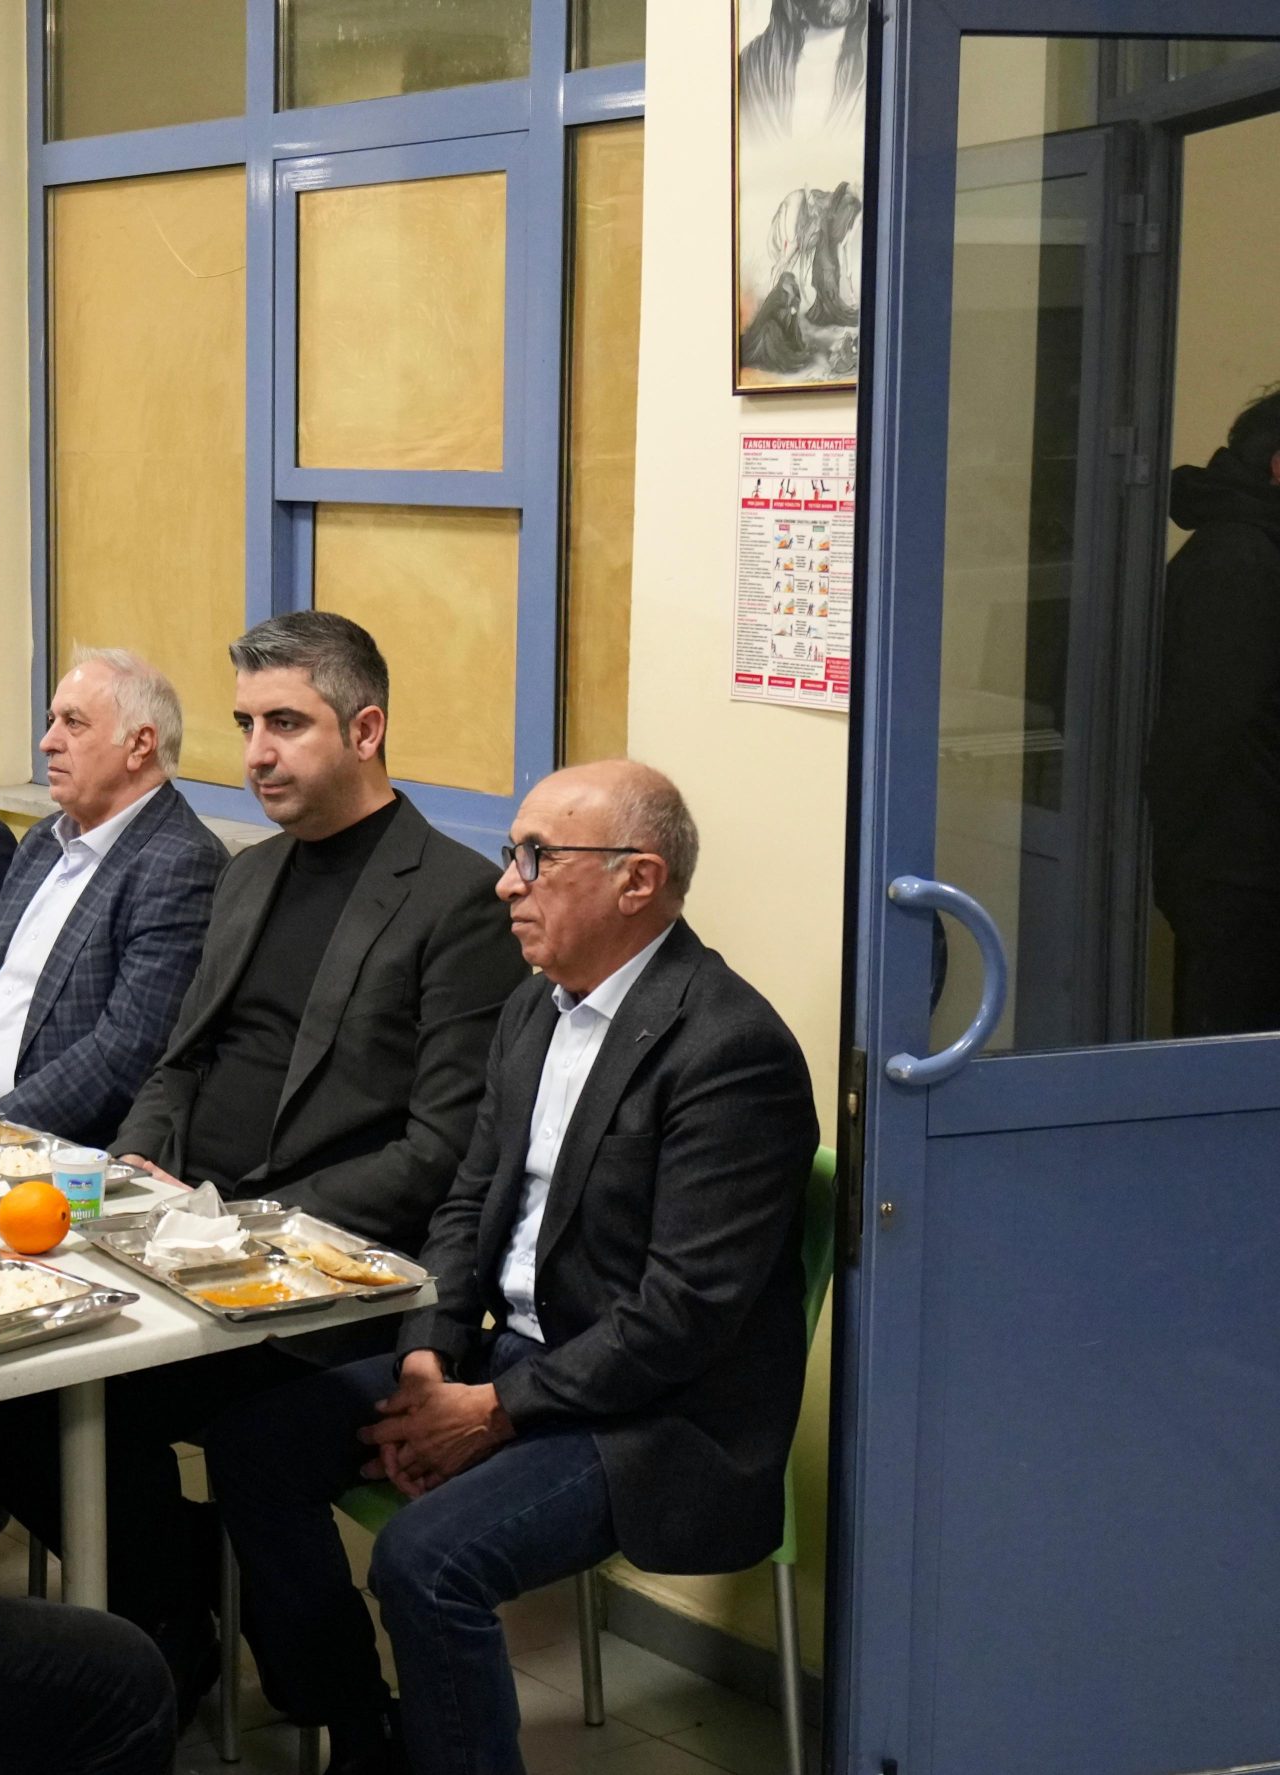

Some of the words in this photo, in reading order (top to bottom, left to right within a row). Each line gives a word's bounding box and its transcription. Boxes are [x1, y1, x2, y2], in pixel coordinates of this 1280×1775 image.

[744, 440, 771, 449] YANGIN
[771, 438, 807, 449] GÜVENLİK
[807, 438, 842, 449] TALİMATI
